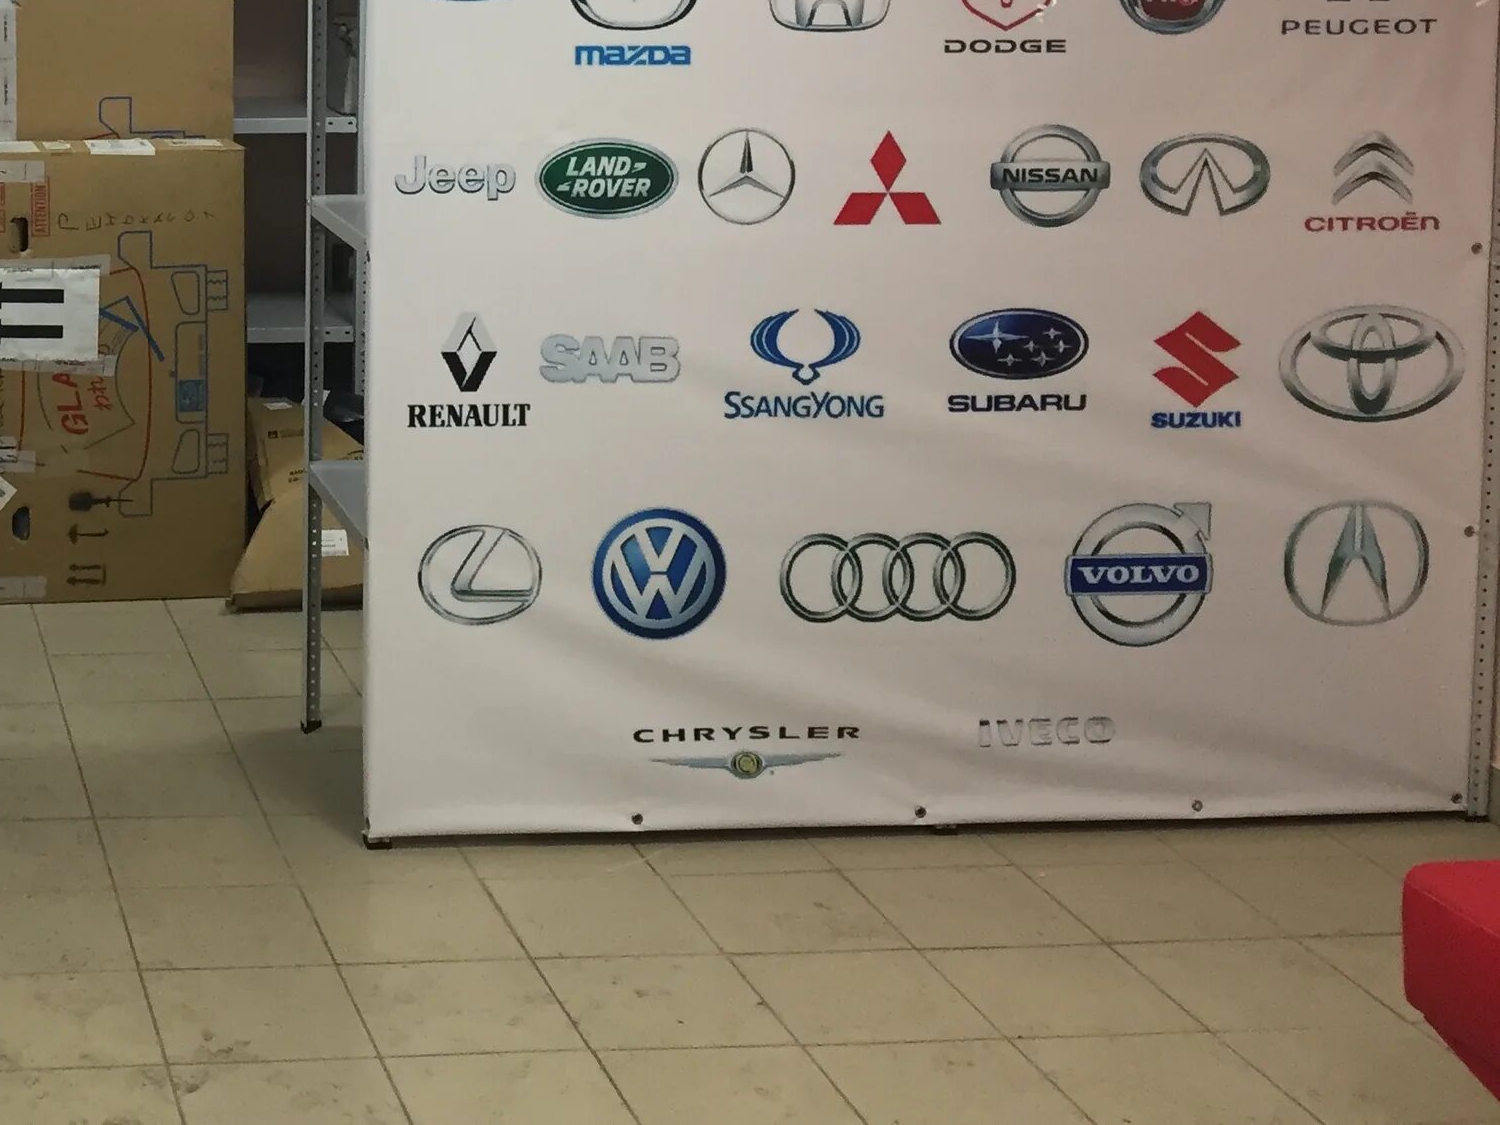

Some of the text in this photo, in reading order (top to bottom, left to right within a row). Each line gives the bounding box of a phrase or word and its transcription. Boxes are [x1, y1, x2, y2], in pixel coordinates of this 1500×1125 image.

[1281, 17, 1439, 36] PEUGEOT
[943, 38, 1068, 54] DODGE
[565, 156, 630, 177] LAND
[1002, 168, 1100, 184] NISSAN
[394, 154, 517, 201] Jeep
[572, 176, 652, 198] ROVER
[539, 333, 682, 383] SAAB
[947, 393, 1088, 413] SUBARU
[407, 402, 532, 428] RENAULT
[1150, 410, 1242, 429] SUZUKI
[1078, 564, 1200, 585] VOLVO
[632, 725, 861, 744] CHRYSLER
[978, 715, 1116, 748] IVECO
